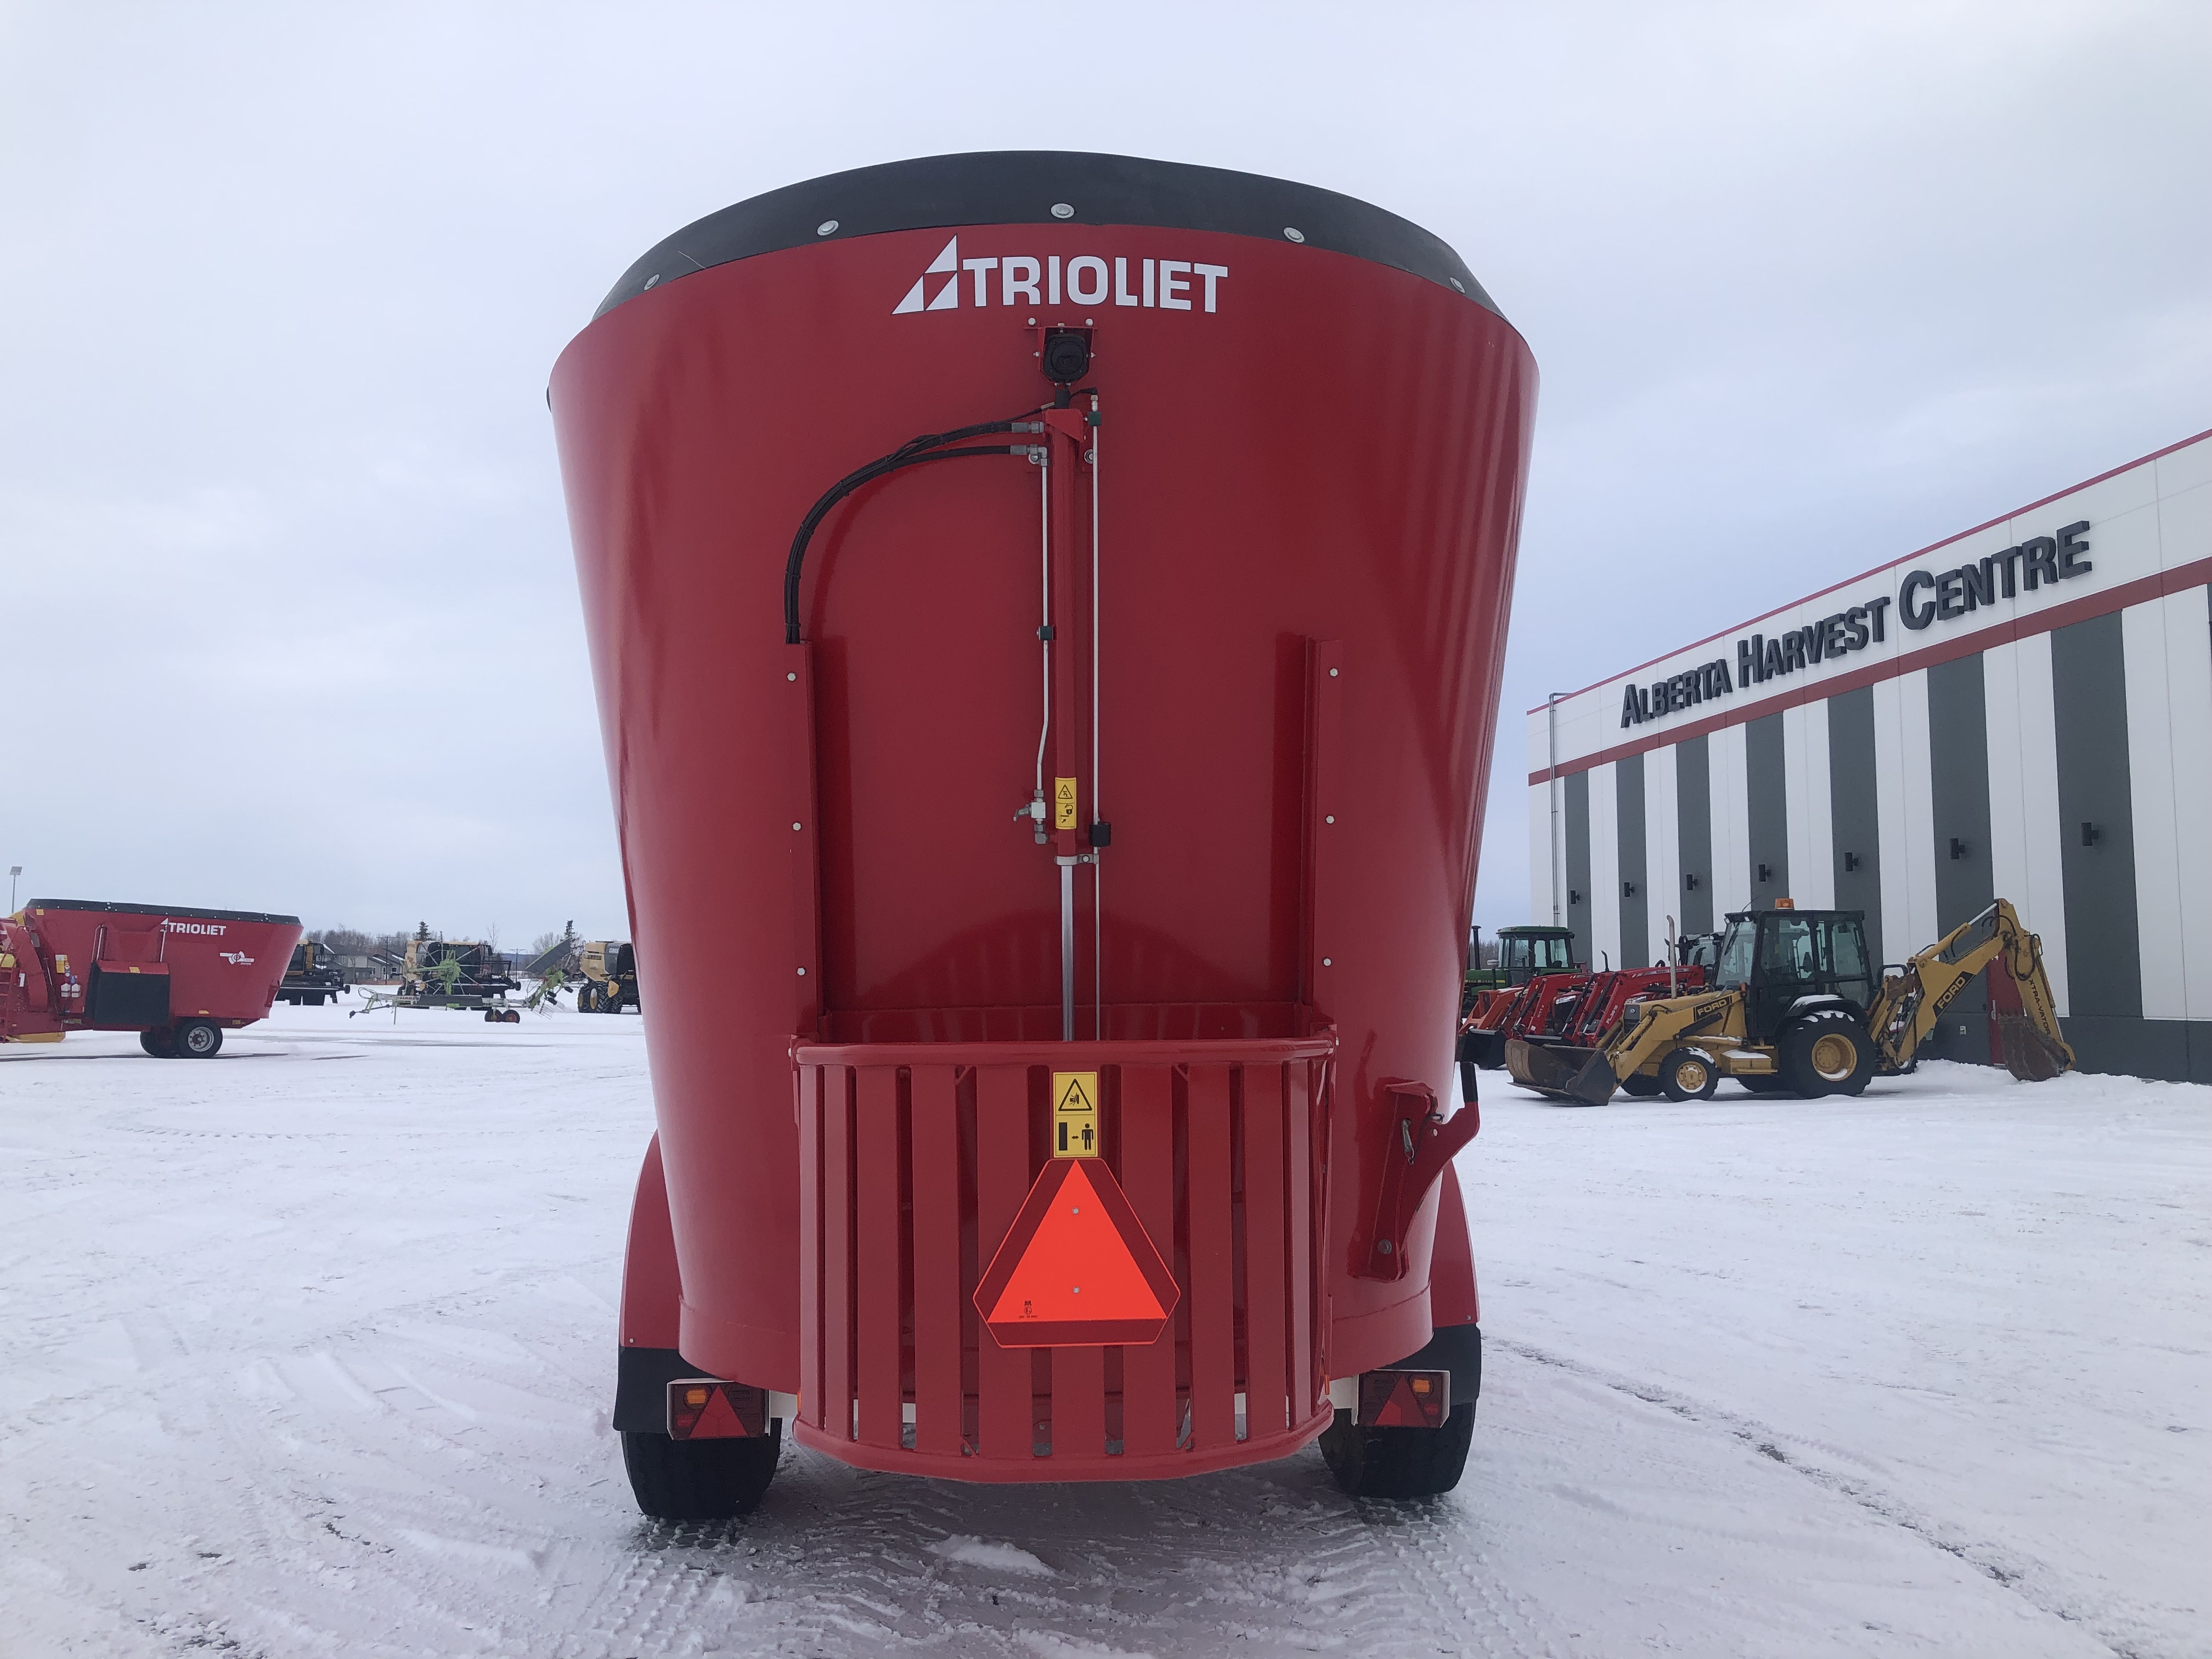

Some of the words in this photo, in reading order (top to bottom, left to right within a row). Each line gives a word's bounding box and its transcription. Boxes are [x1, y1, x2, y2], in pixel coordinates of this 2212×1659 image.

[963, 256, 1228, 313] TRIOLIET
[1620, 658, 1733, 729] ALBERTA
[1737, 596, 1890, 689] HARVEST
[1899, 520, 2092, 630] CENTRE
[168, 922, 227, 936] TRIOLIET
[1697, 999, 1727, 1016] FORD
[1937, 977, 1966, 1009] FORD
